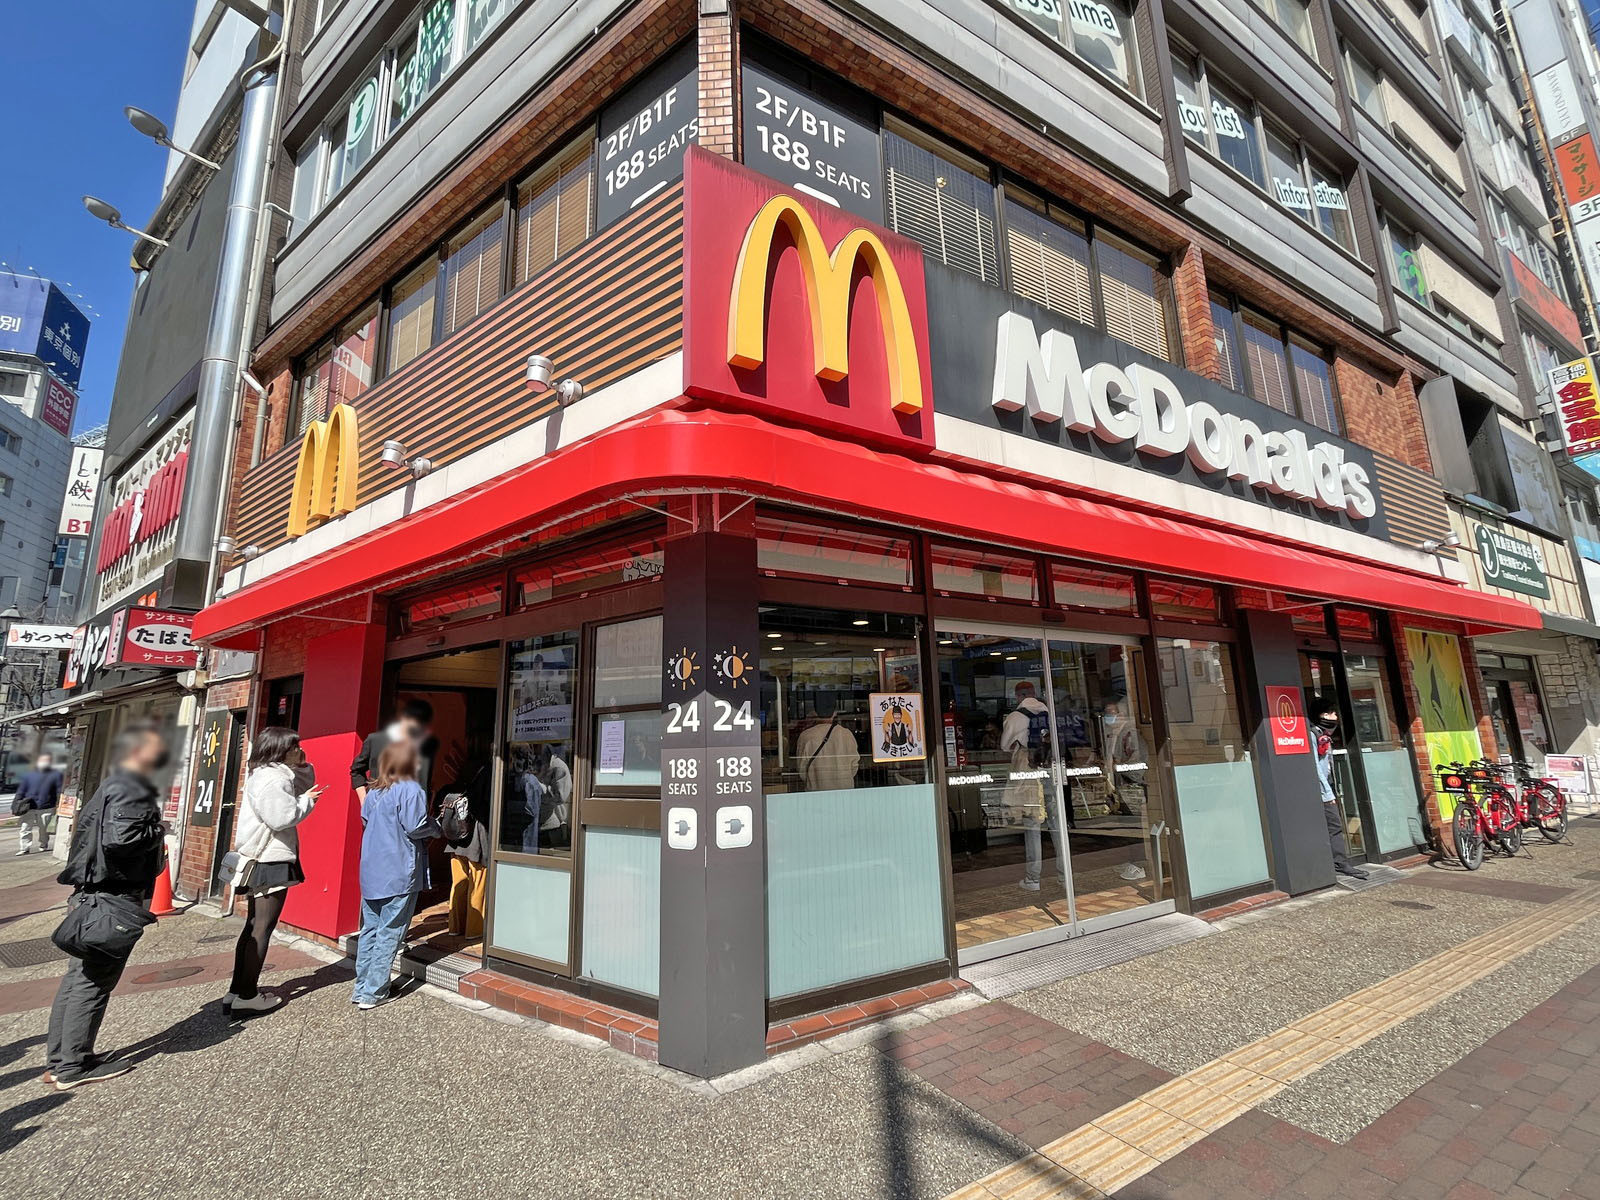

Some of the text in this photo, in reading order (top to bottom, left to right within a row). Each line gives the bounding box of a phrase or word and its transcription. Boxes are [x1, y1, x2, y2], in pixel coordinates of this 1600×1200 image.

[605, 87, 677, 161] 2F/B1F
[755, 87, 846, 149] 2F/B1F
[1560, 128, 1581, 143] 6F
[605, 117, 699, 197] 188 SEATS
[756, 125, 872, 200] 188 SEATS
[1566, 141, 1596, 198] マッサージ
[43, 325, 81, 369] 東京個別
[50, 384, 72, 410] ECC
[991, 310, 1377, 520] McDonald's
[144, 611, 193, 624] サンキュー
[21, 630, 74, 643] かつや
[142, 652, 186, 663] サービス
[666, 700, 701, 734] 24
[713, 700, 755, 732] 24
[879, 696, 914, 713] あなたと
[668, 758, 698, 779] 188
[715, 756, 753, 778] 188
[194, 779, 215, 814] 24
[667, 782, 698, 796] SEATS
[715, 780, 753, 795] SEATS
